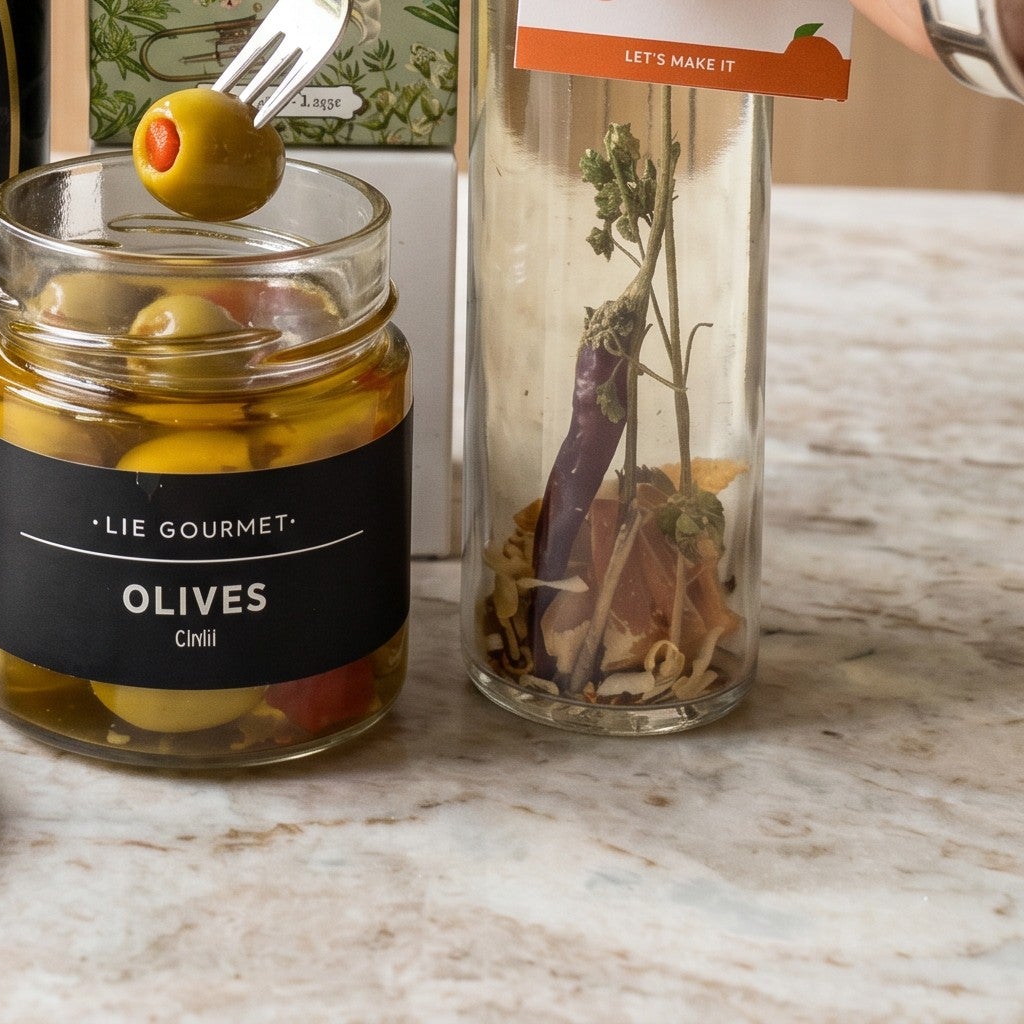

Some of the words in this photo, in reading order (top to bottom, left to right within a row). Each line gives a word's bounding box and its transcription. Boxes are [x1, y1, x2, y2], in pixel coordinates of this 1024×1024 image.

[624, 49, 667, 67] LET'S
[670, 54, 717, 71] MAKE
[720, 59, 736, 73] IT
[122, 582, 268, 616] OLIVES
